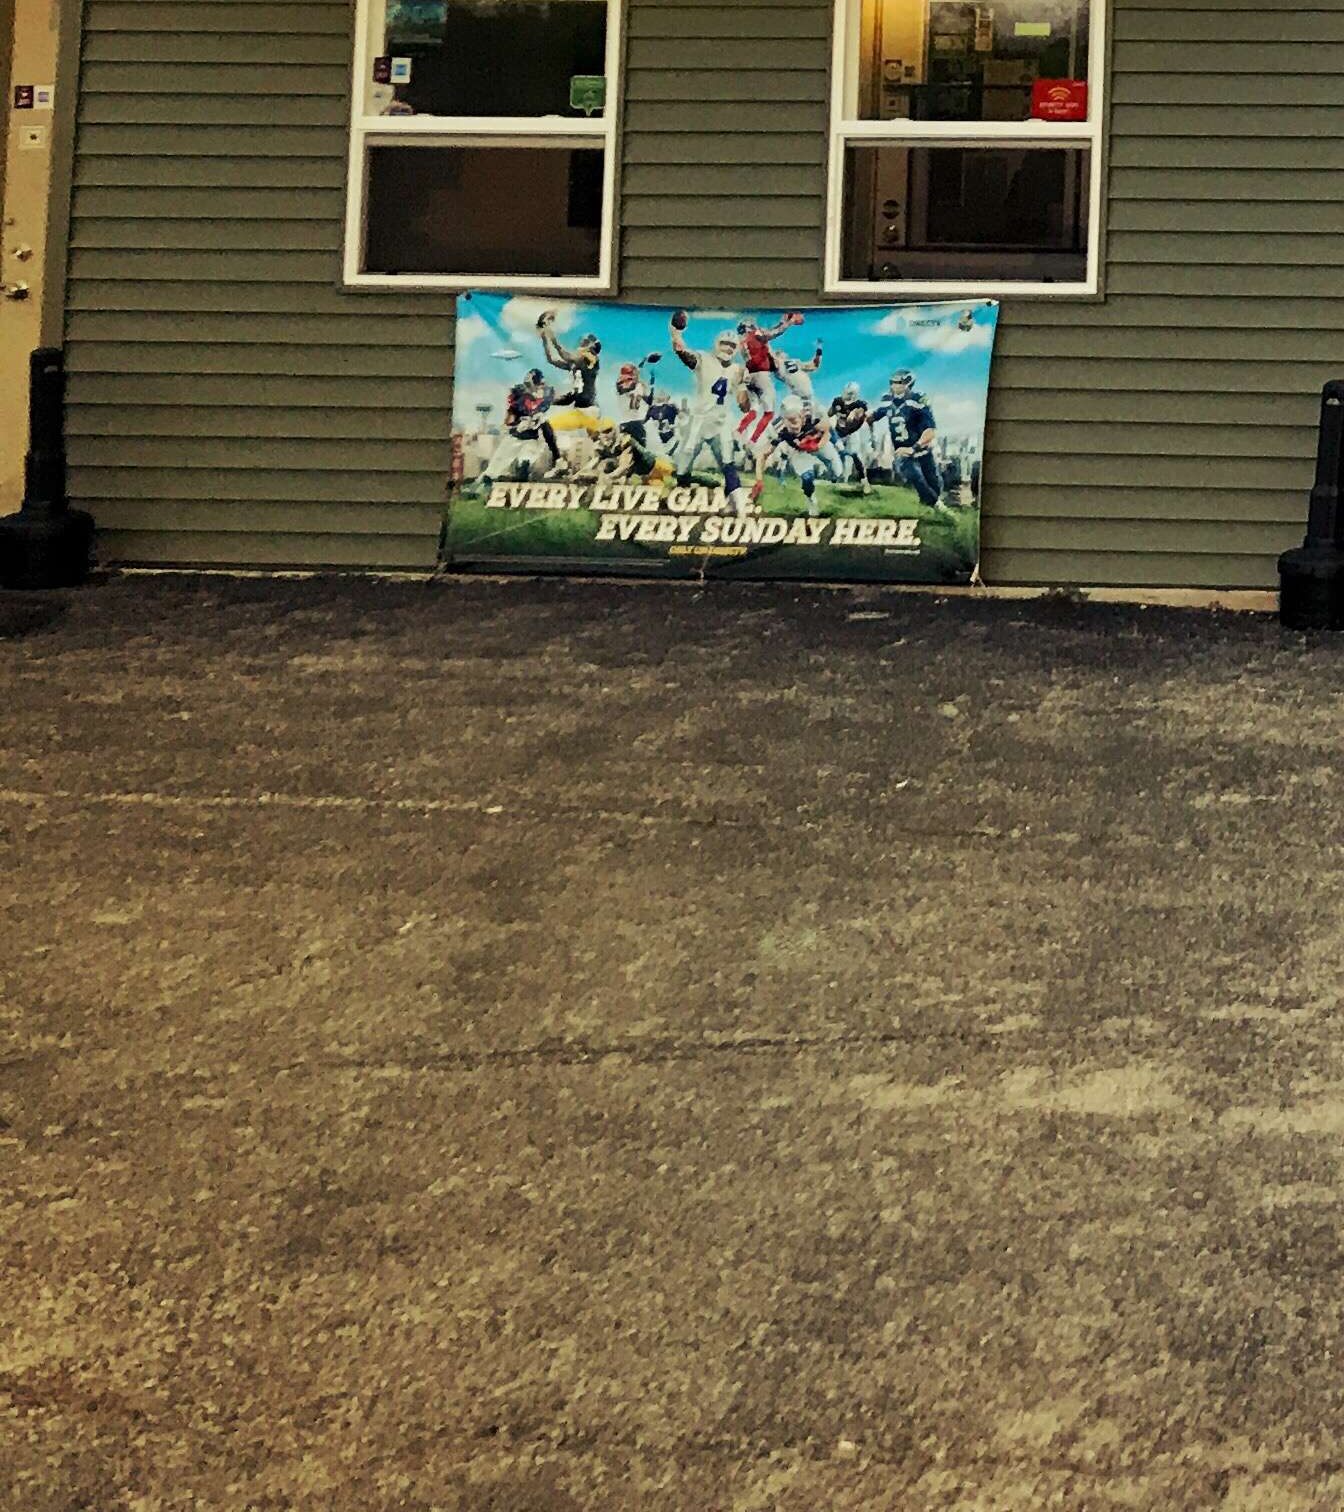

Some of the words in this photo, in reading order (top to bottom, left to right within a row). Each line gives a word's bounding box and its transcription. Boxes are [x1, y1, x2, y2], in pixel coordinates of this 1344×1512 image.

[711, 377, 728, 405] 4
[485, 482, 587, 510] EVERY
[588, 484, 666, 513] LIVE
[595, 513, 701, 542] EVERY
[700, 516, 830, 545] SUNDAY
[829, 519, 921, 546] HERE.
